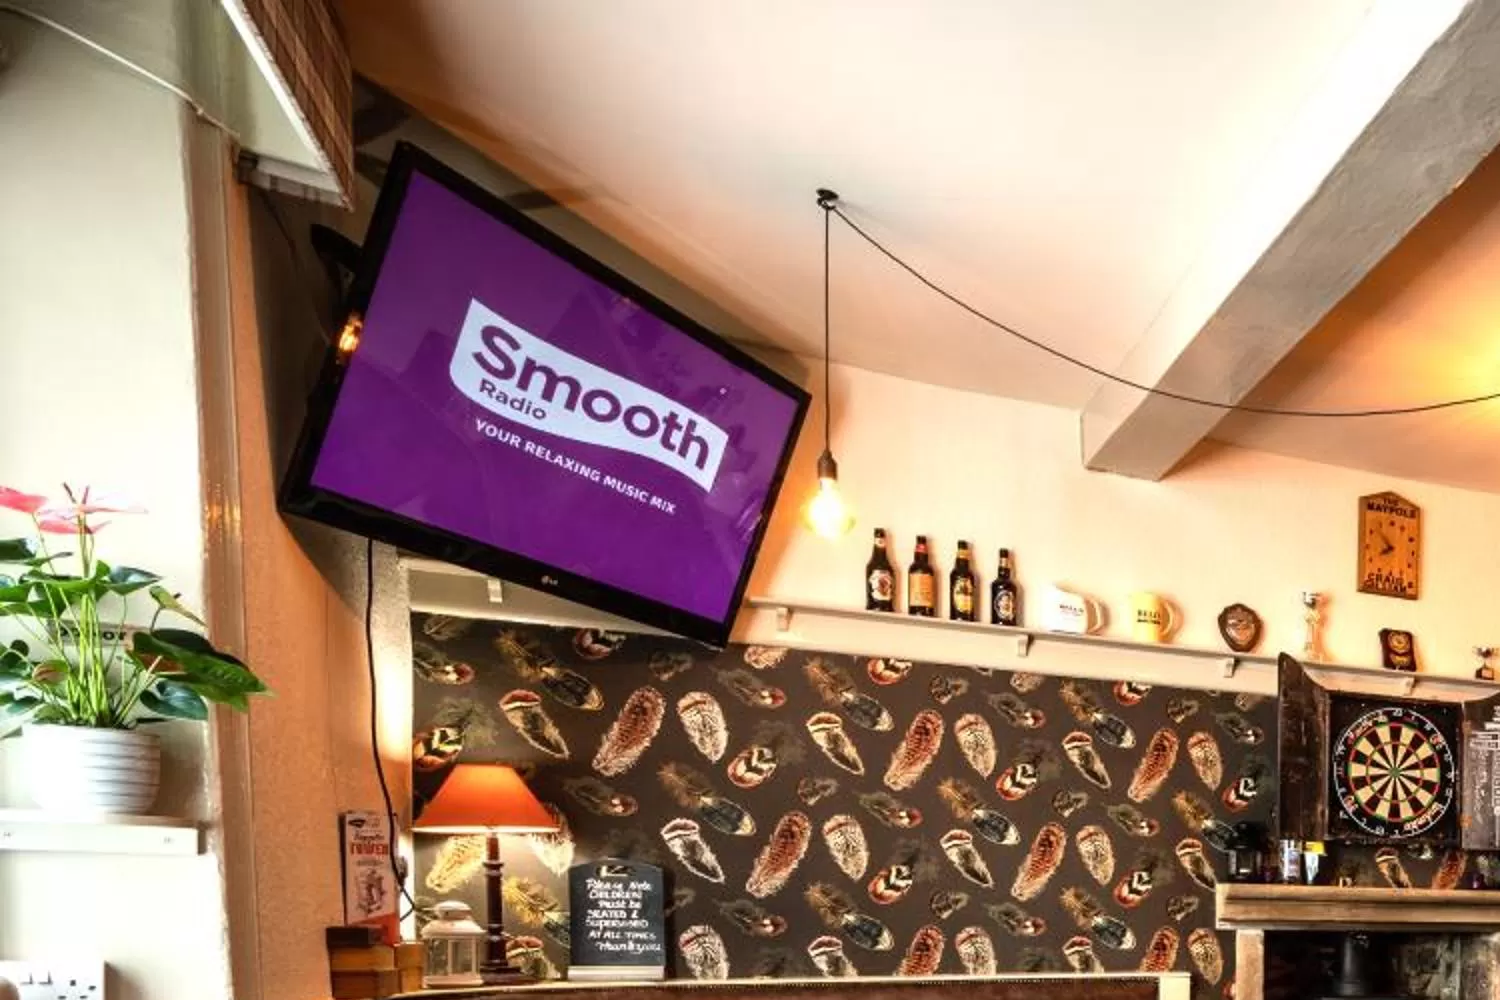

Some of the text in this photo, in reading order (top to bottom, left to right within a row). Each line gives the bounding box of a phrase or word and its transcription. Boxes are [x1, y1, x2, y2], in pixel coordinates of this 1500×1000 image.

[472, 325, 712, 470] Smooth
[479, 377, 547, 420] Radio
[475, 417, 677, 515] YOUR RELAXING MUSIC MIX
[1367, 501, 1417, 519] MAYPOLE
[586, 909, 627, 919] SEATED
